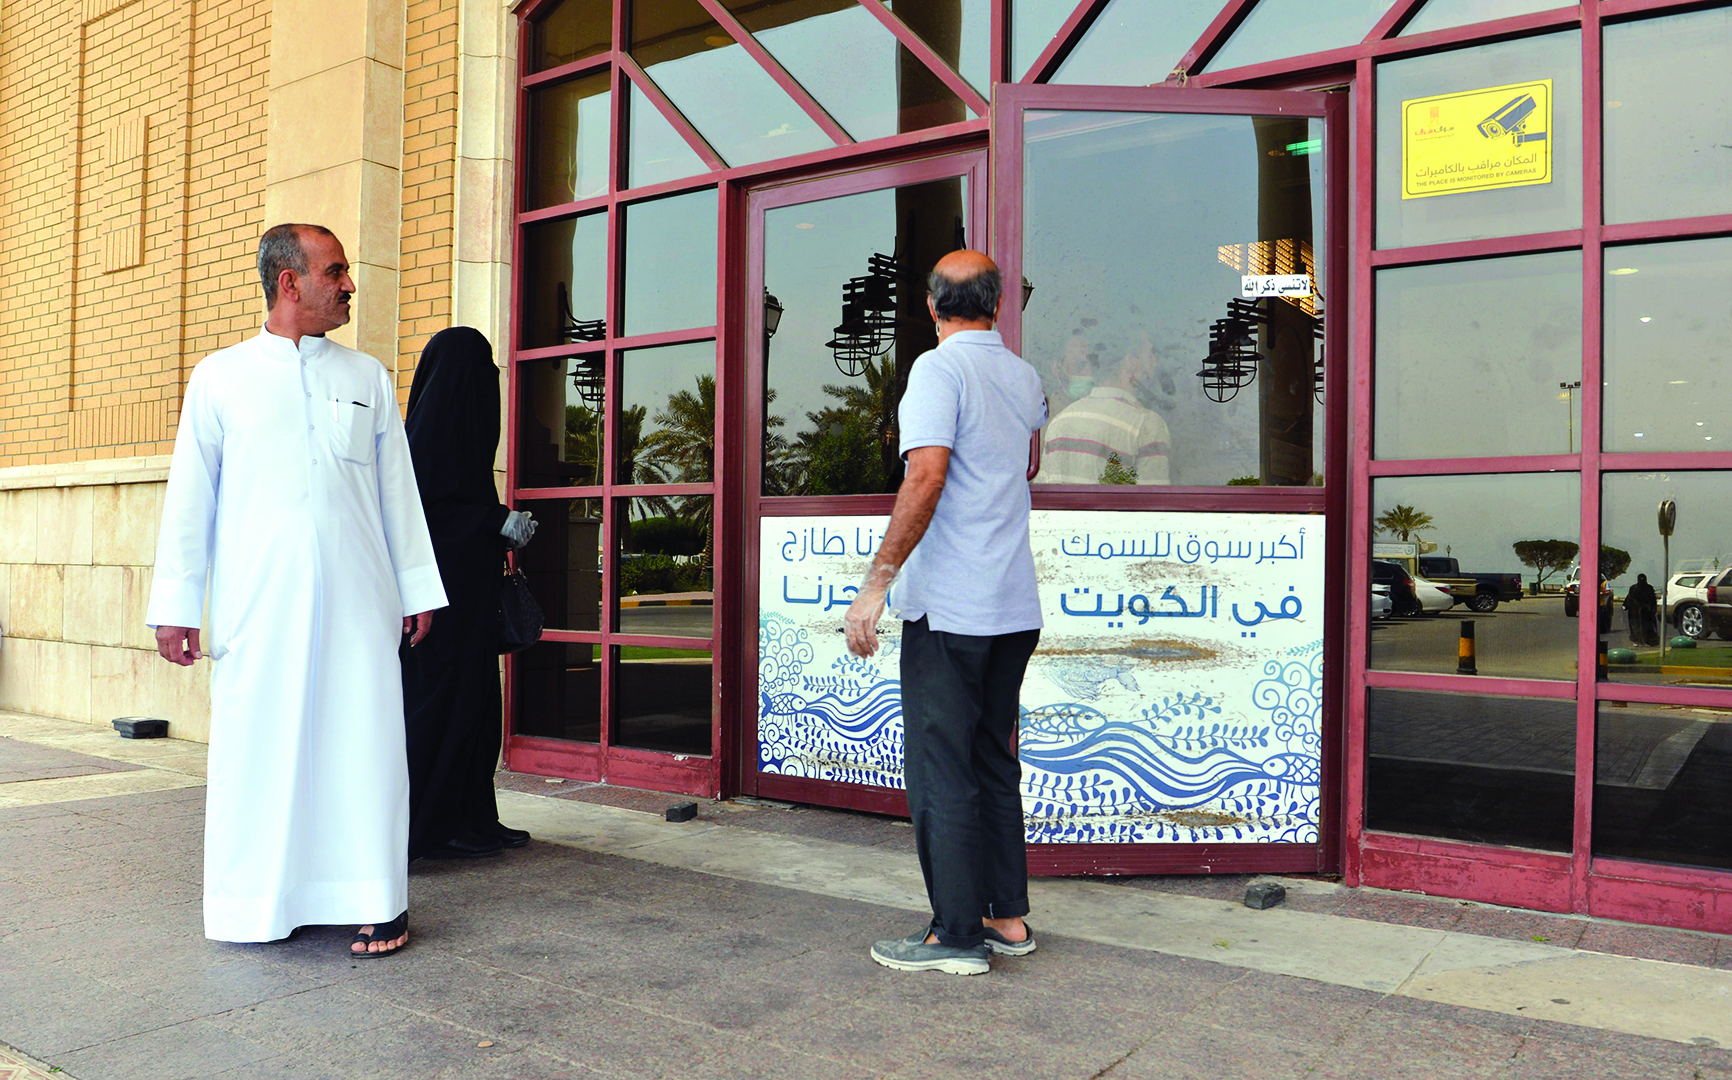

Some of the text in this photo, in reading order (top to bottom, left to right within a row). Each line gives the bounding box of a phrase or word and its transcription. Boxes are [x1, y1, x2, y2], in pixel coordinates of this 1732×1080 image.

[1415, 153, 1537, 178] المكان مراقب بالكاميرات
[1457, 173, 1495, 182] MONITORED
[1505, 168, 1537, 177] CAMERAS
[1244, 278, 1258, 292] الله
[1260, 278, 1276, 294] ذكر
[781, 527, 845, 562] طازج
[1061, 527, 1306, 564] أكبر سوق للسمك
[1060, 585, 1303, 638] في الكويت
